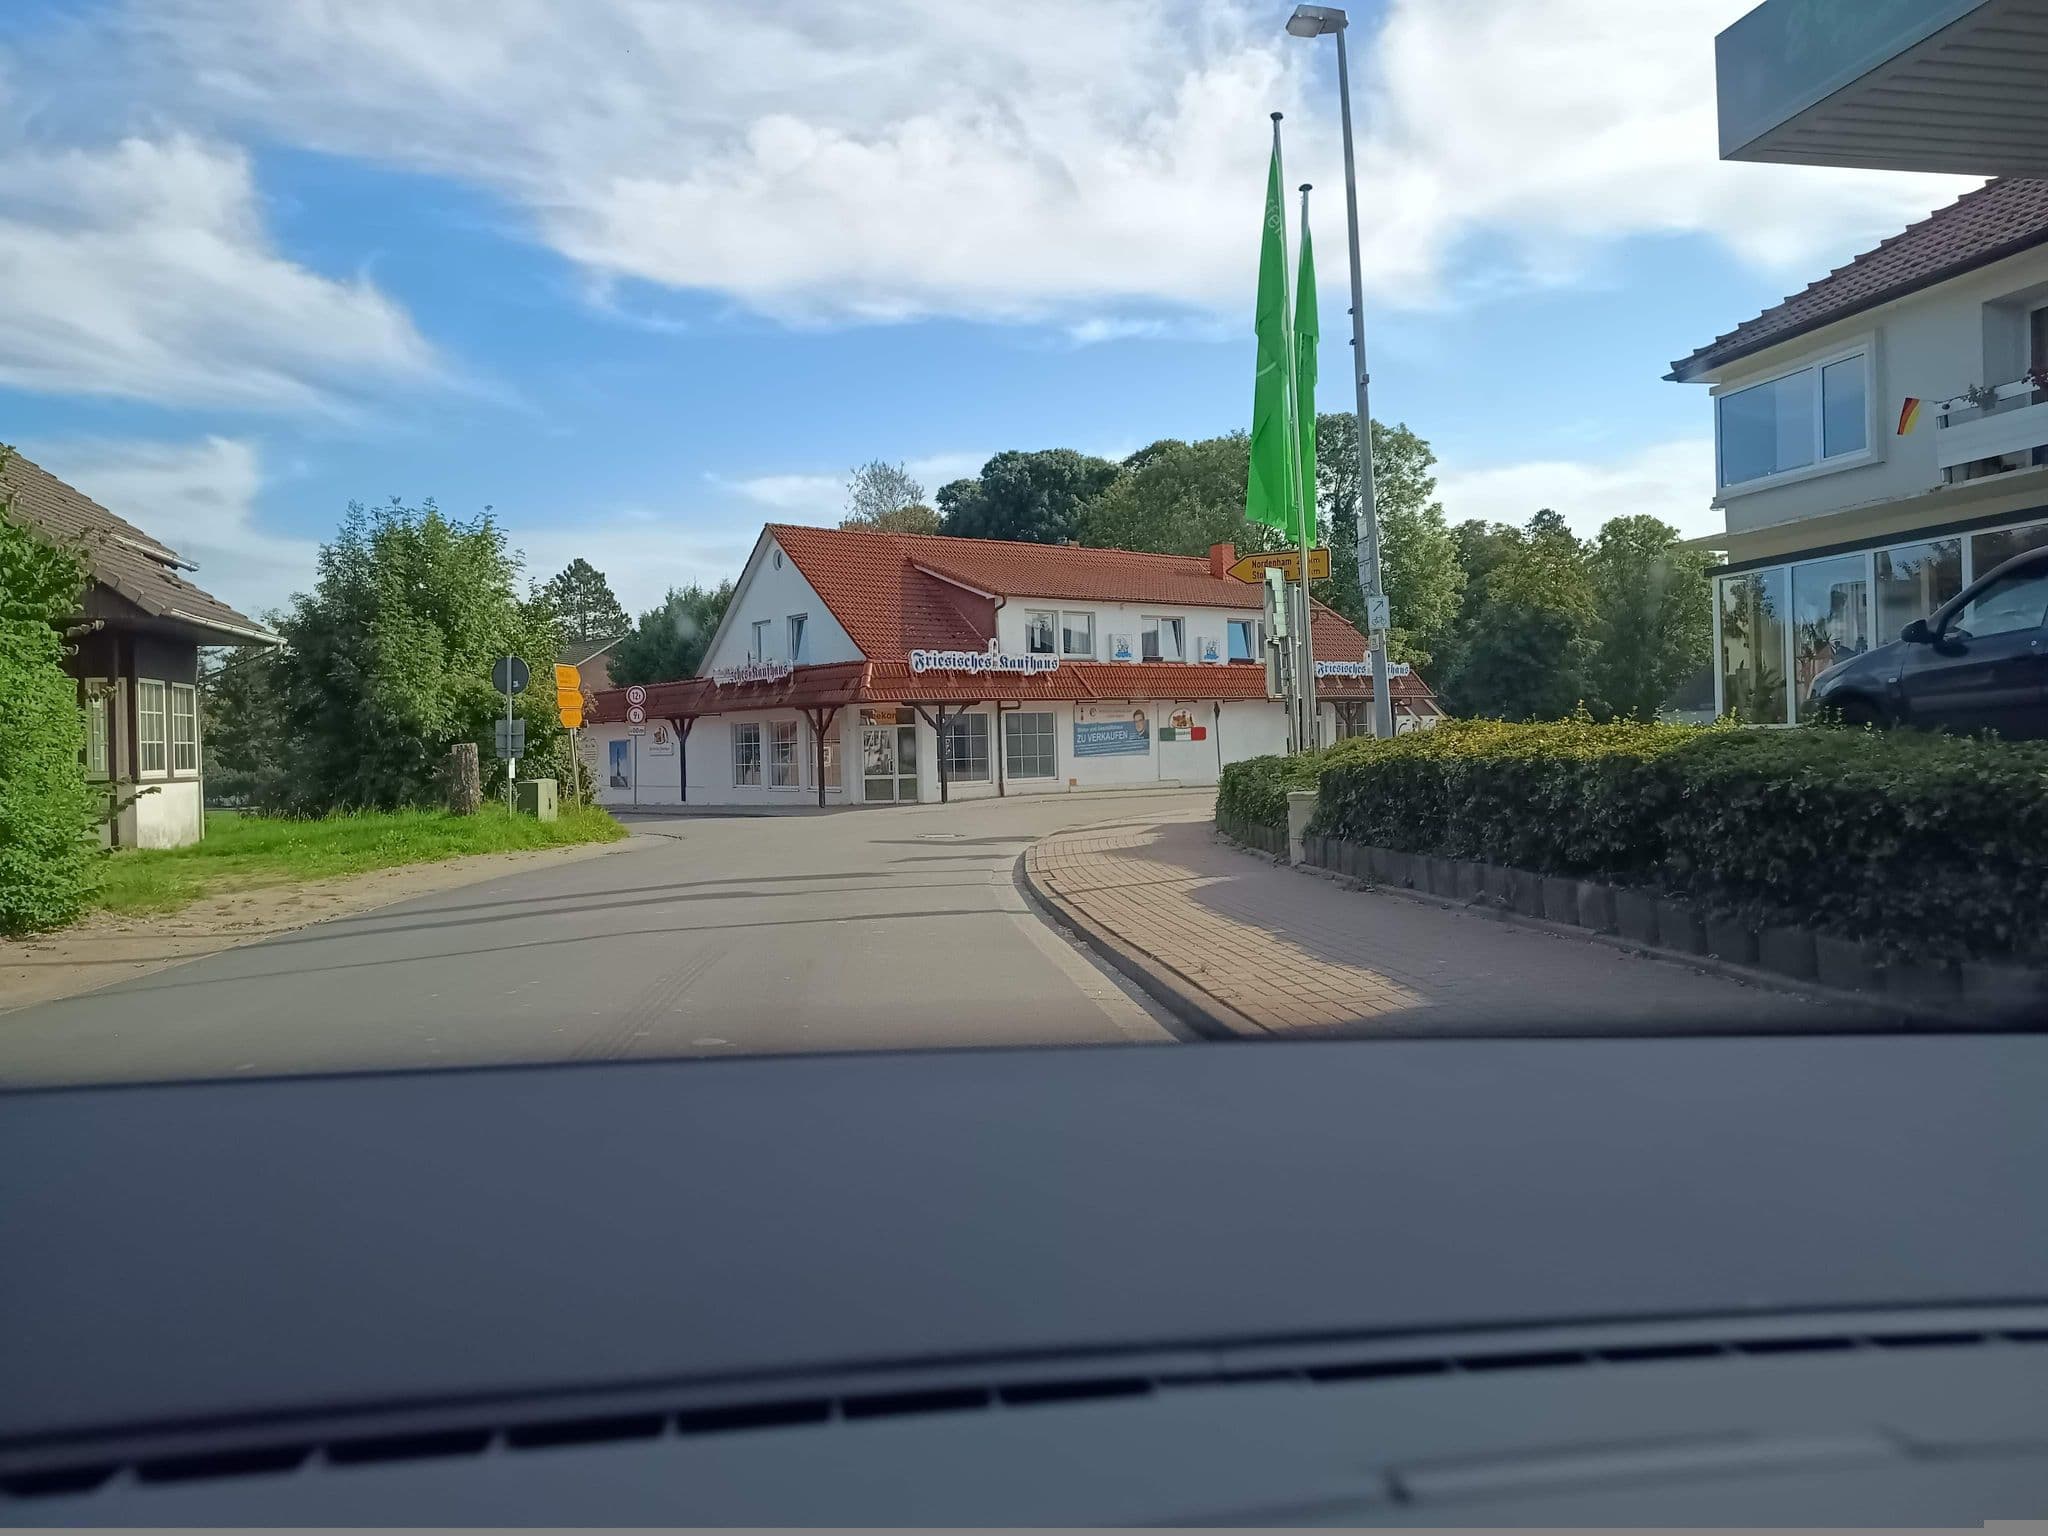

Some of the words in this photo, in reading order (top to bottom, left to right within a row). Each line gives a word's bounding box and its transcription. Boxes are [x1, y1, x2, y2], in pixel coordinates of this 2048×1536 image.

[1252, 558, 1292, 569] Nordenham
[912, 652, 992, 671] Friesisches
[999, 654, 1058, 674] Kaufhaus
[1317, 662, 1367, 676] Friesisches
[1076, 734, 1087, 743] ZU
[1087, 730, 1129, 743] VERKAUFEN
